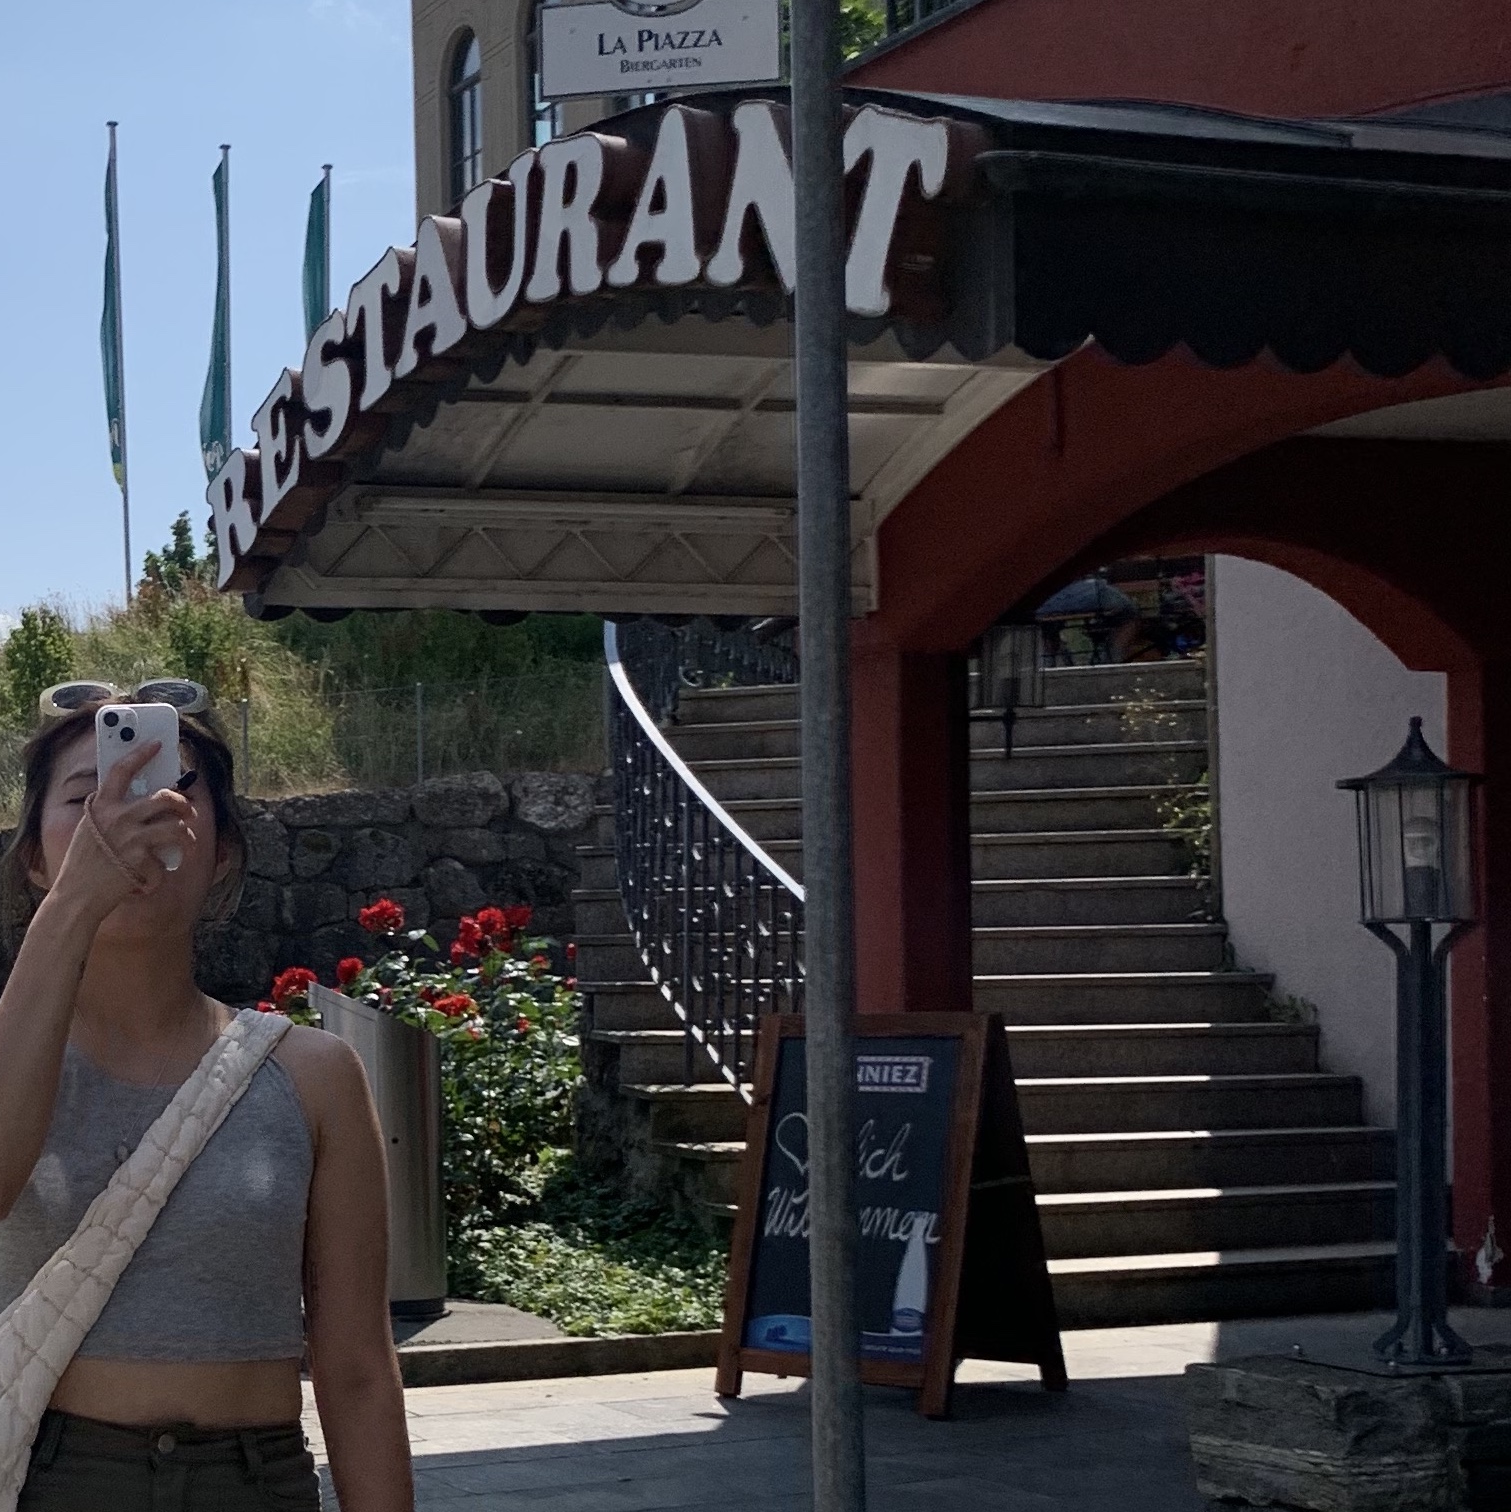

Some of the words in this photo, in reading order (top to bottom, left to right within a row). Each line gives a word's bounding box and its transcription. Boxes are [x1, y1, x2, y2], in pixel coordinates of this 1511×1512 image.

[598, 33, 627, 56] LA
[638, 29, 723, 52] PIAZZA
[620, 57, 702, 73] BIERGARTEN
[206, 99, 950, 591] RESTAURANT
[857, 1064, 919, 1084] NIEZ
